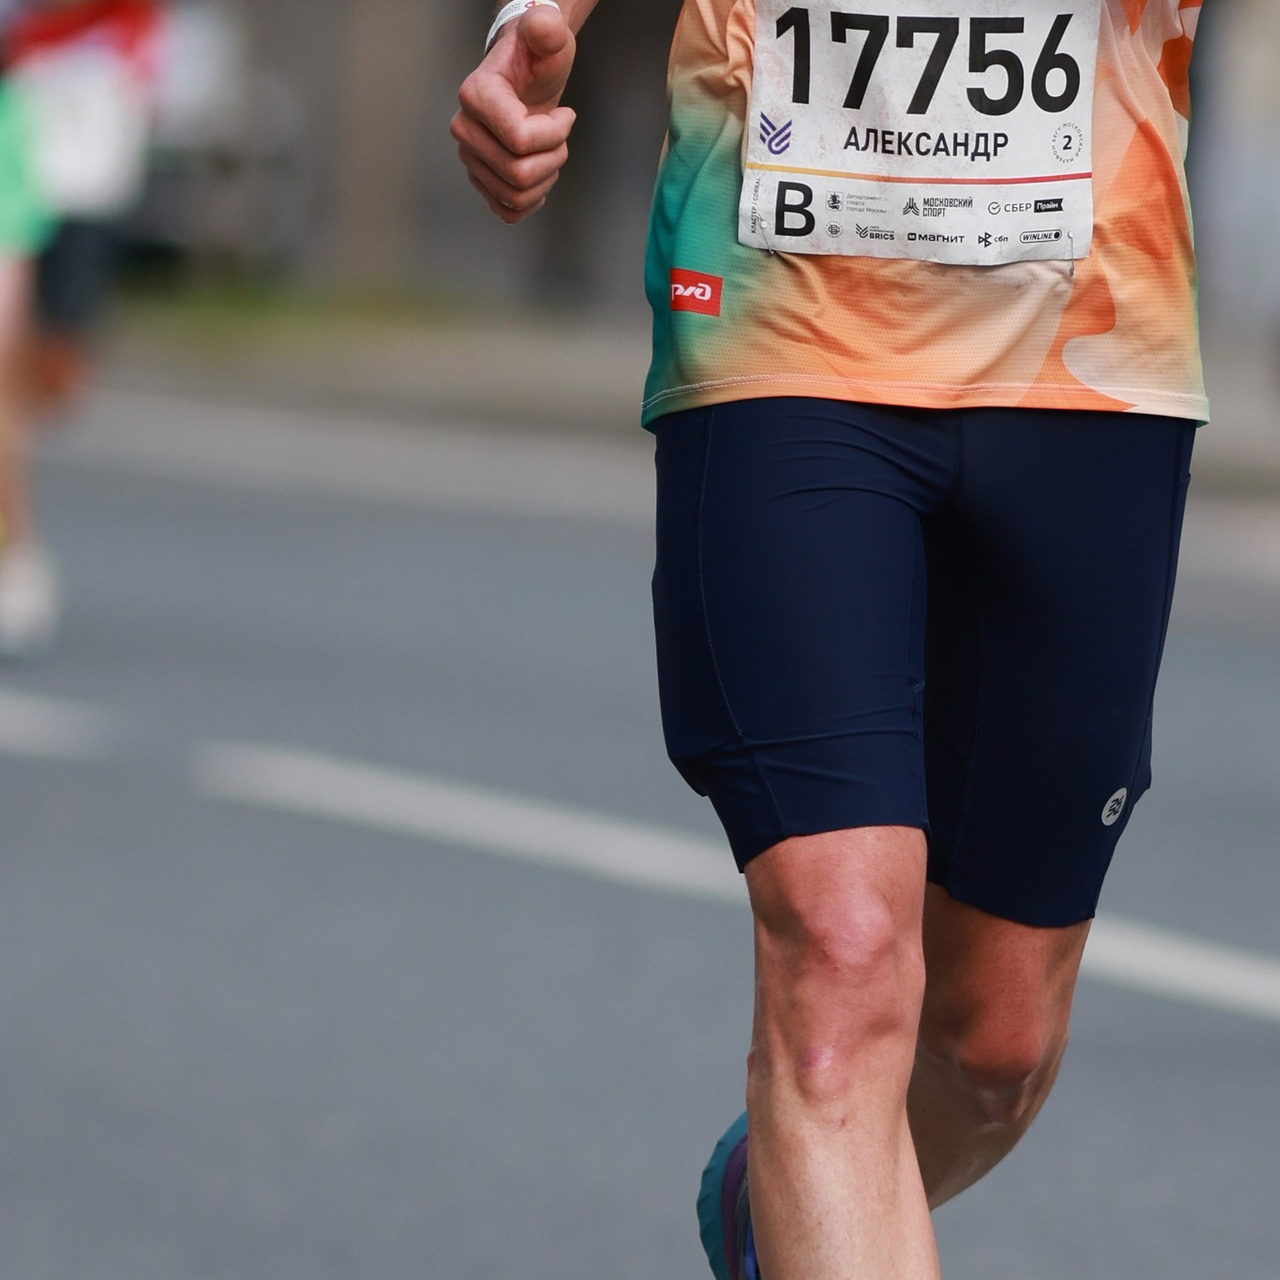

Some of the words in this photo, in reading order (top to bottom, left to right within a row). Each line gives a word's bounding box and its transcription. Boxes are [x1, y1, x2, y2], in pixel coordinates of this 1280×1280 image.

[776, 6, 1081, 116] 17756
[843, 126, 1009, 162] АЛЕКСАНДР
[1062, 134, 1072, 150] 2
[922, 196, 973, 208] МОСКОВСКИЙ
[922, 208, 946, 217] СПОРТ
[1004, 203, 1032, 212] СБЕР
[869, 233, 895, 241] BRICS
[1022, 233, 1053, 241] WINLINE
